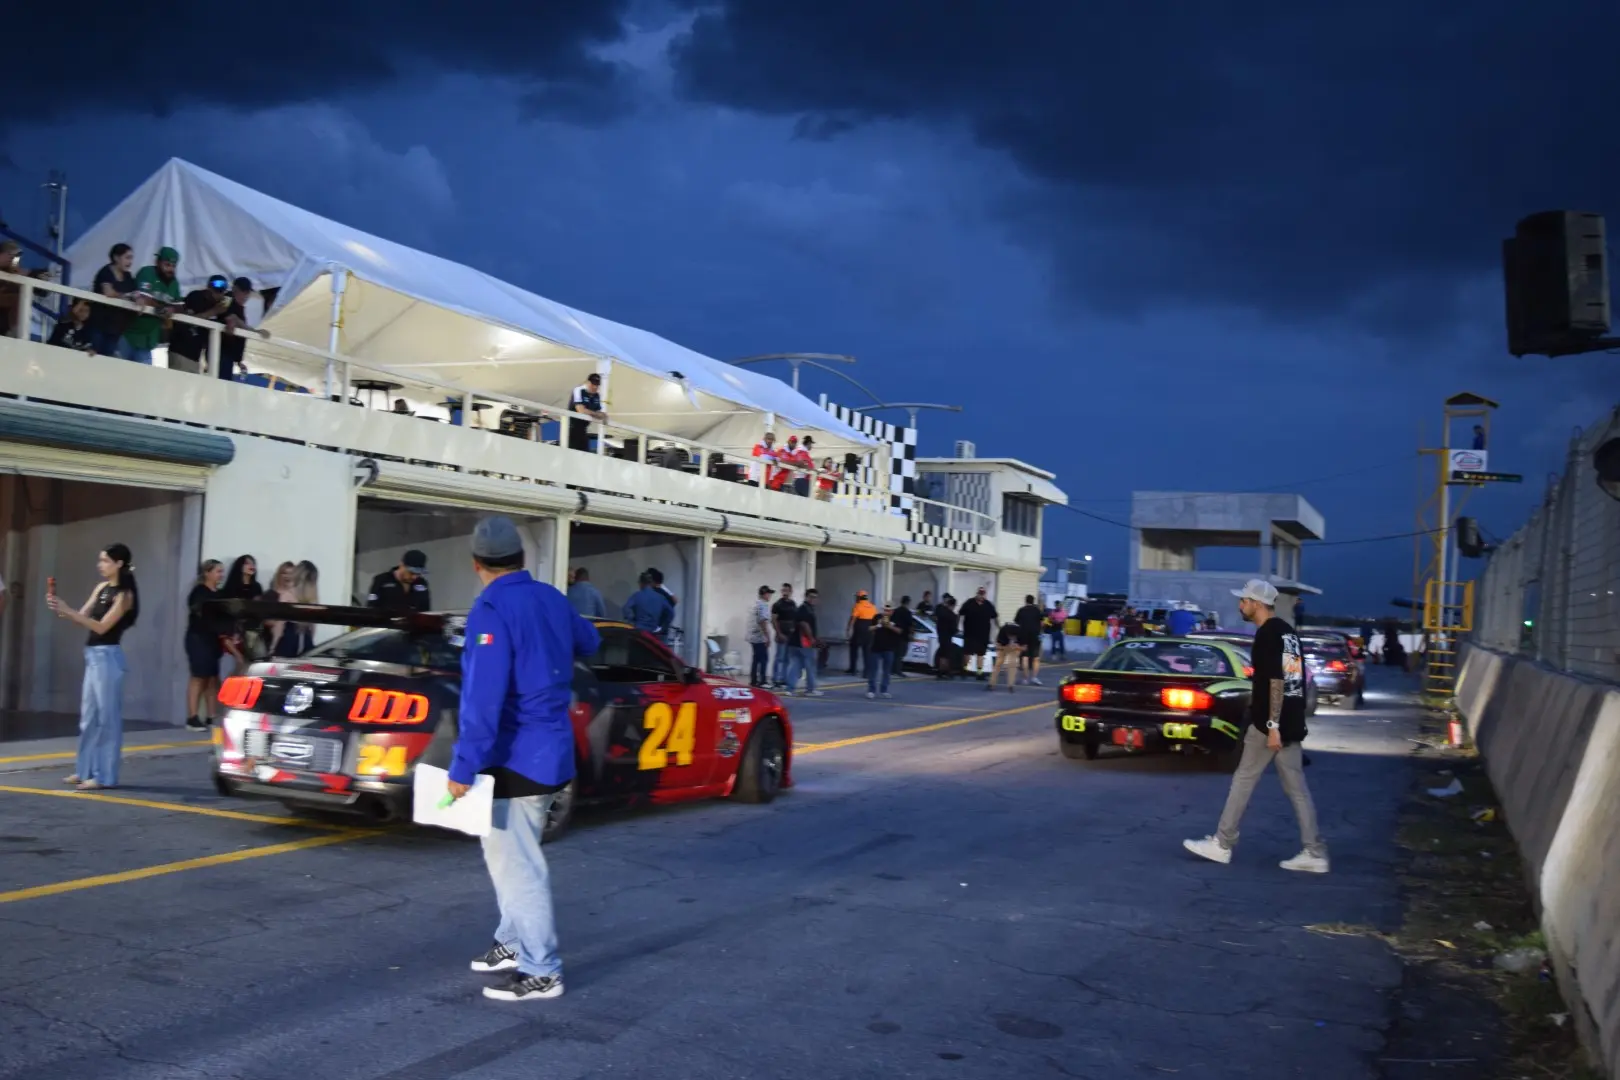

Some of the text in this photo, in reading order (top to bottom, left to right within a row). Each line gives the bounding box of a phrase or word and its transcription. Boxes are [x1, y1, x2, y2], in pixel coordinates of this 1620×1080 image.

[637, 701, 697, 770] 24
[1062, 715, 1086, 732] 03
[356, 744, 408, 776] 24
